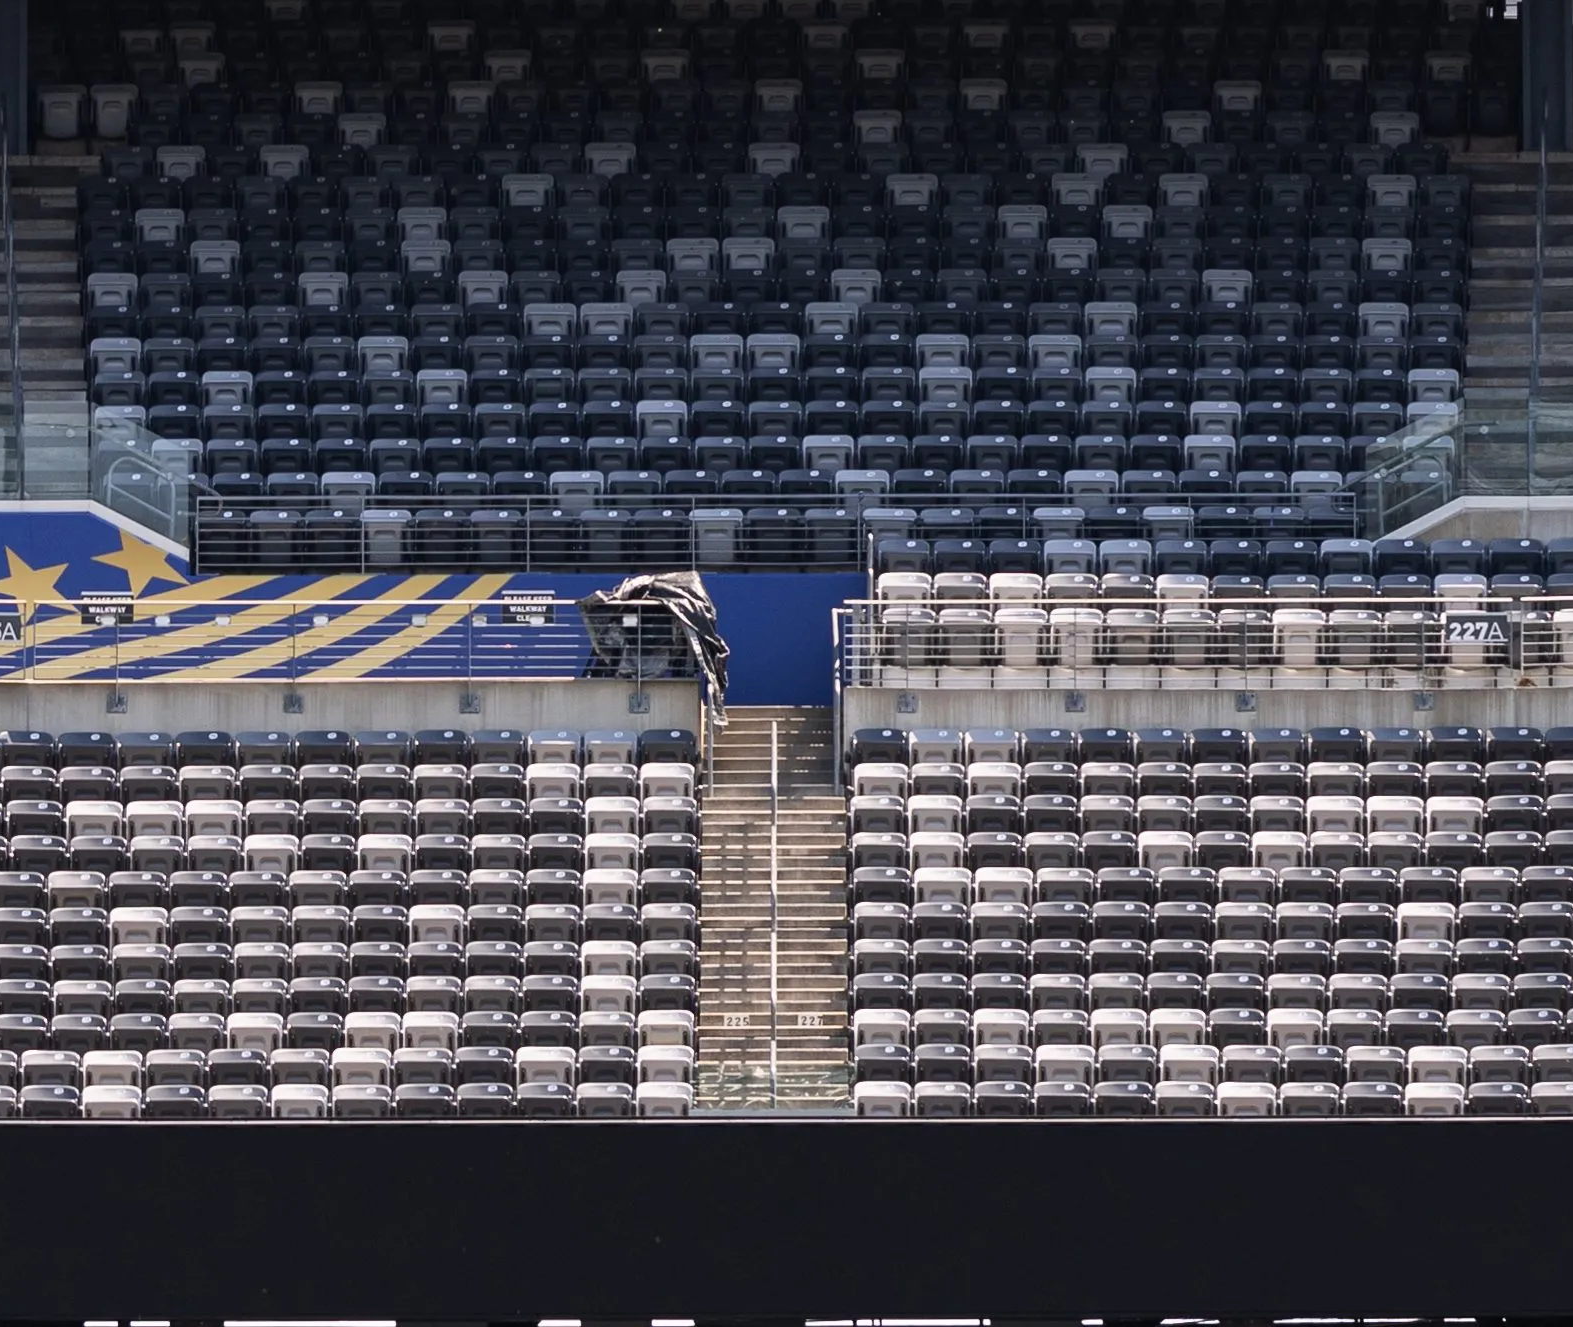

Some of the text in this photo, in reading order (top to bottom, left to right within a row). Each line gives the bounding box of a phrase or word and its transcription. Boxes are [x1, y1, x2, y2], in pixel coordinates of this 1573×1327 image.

[88, 606, 127, 614] WALKWAY
[1448, 622, 1505, 643] 227A
[726, 1017, 749, 1027] 225
[801, 1016, 824, 1026] 227
